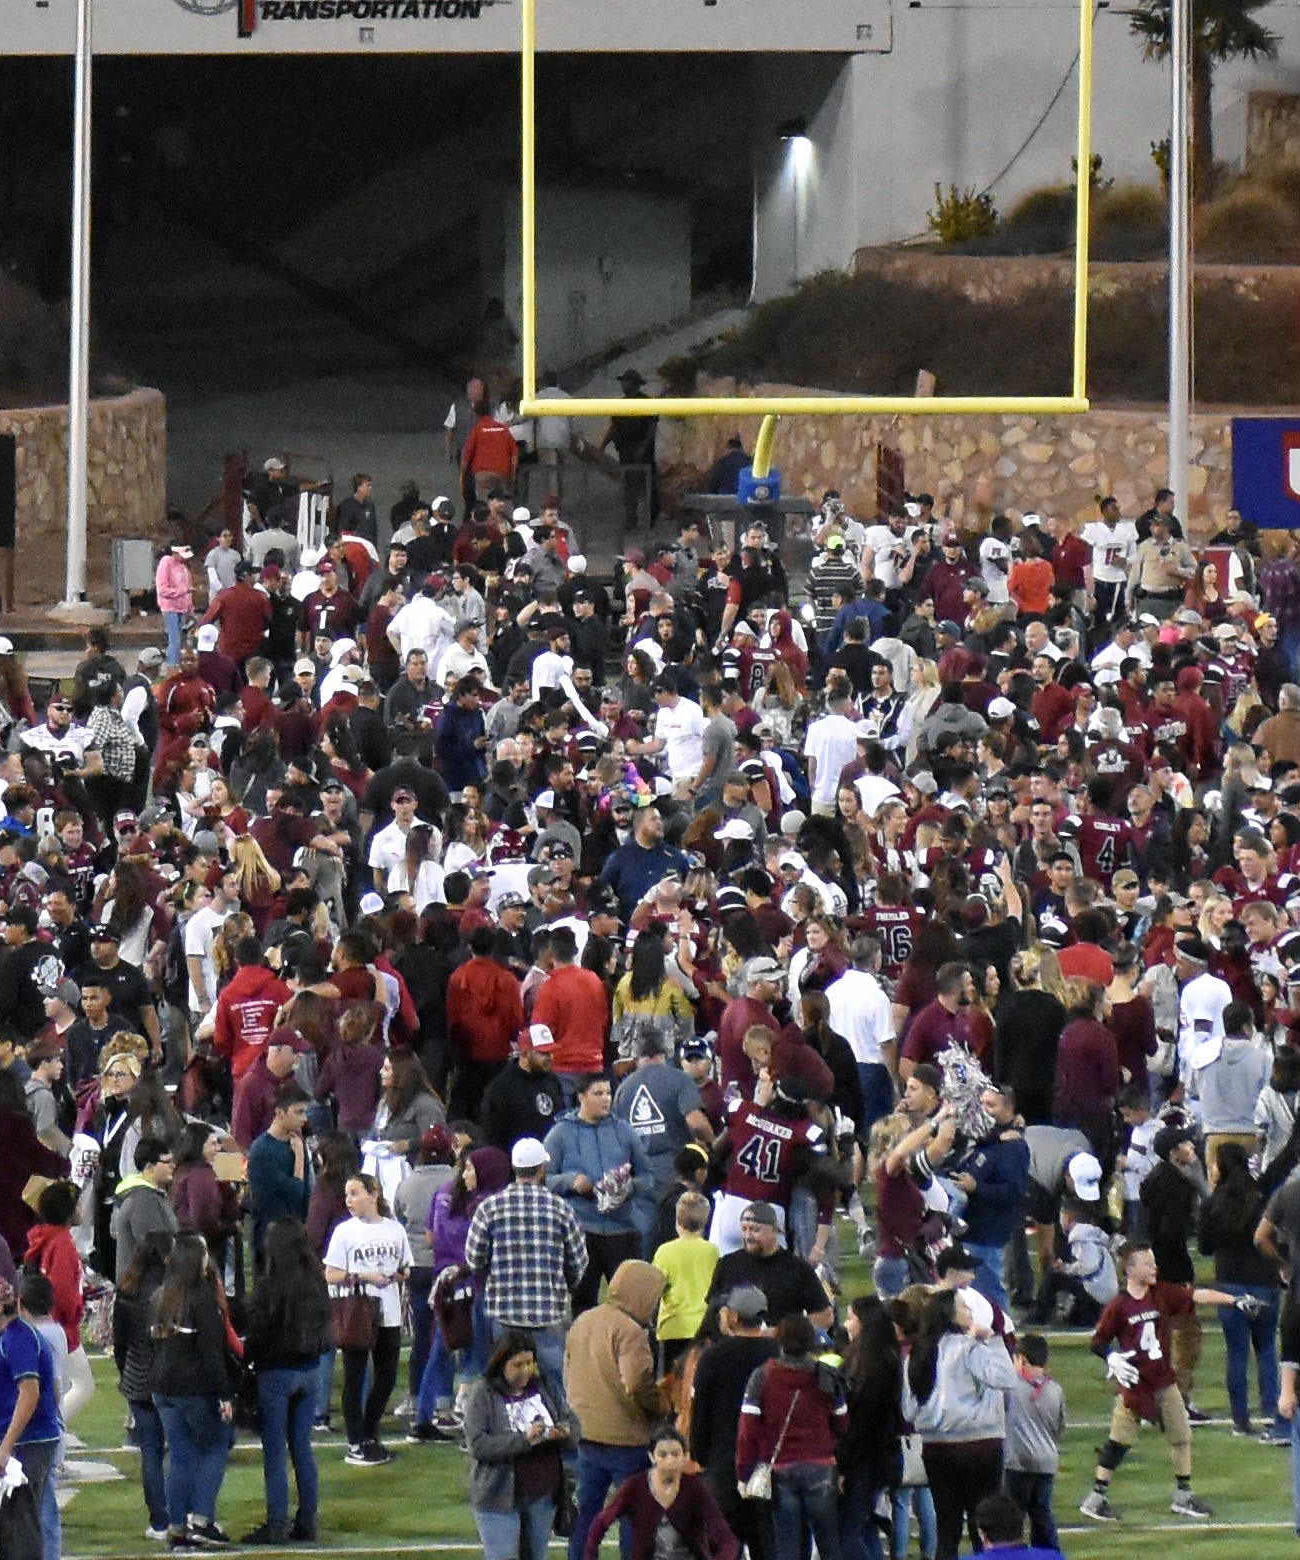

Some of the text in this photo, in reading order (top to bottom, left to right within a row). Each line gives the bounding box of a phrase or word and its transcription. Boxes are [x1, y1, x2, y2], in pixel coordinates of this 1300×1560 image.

[1097, 836, 1114, 873] 4
[738, 1134, 781, 1183] 41
[1140, 1321, 1163, 1360] 4
